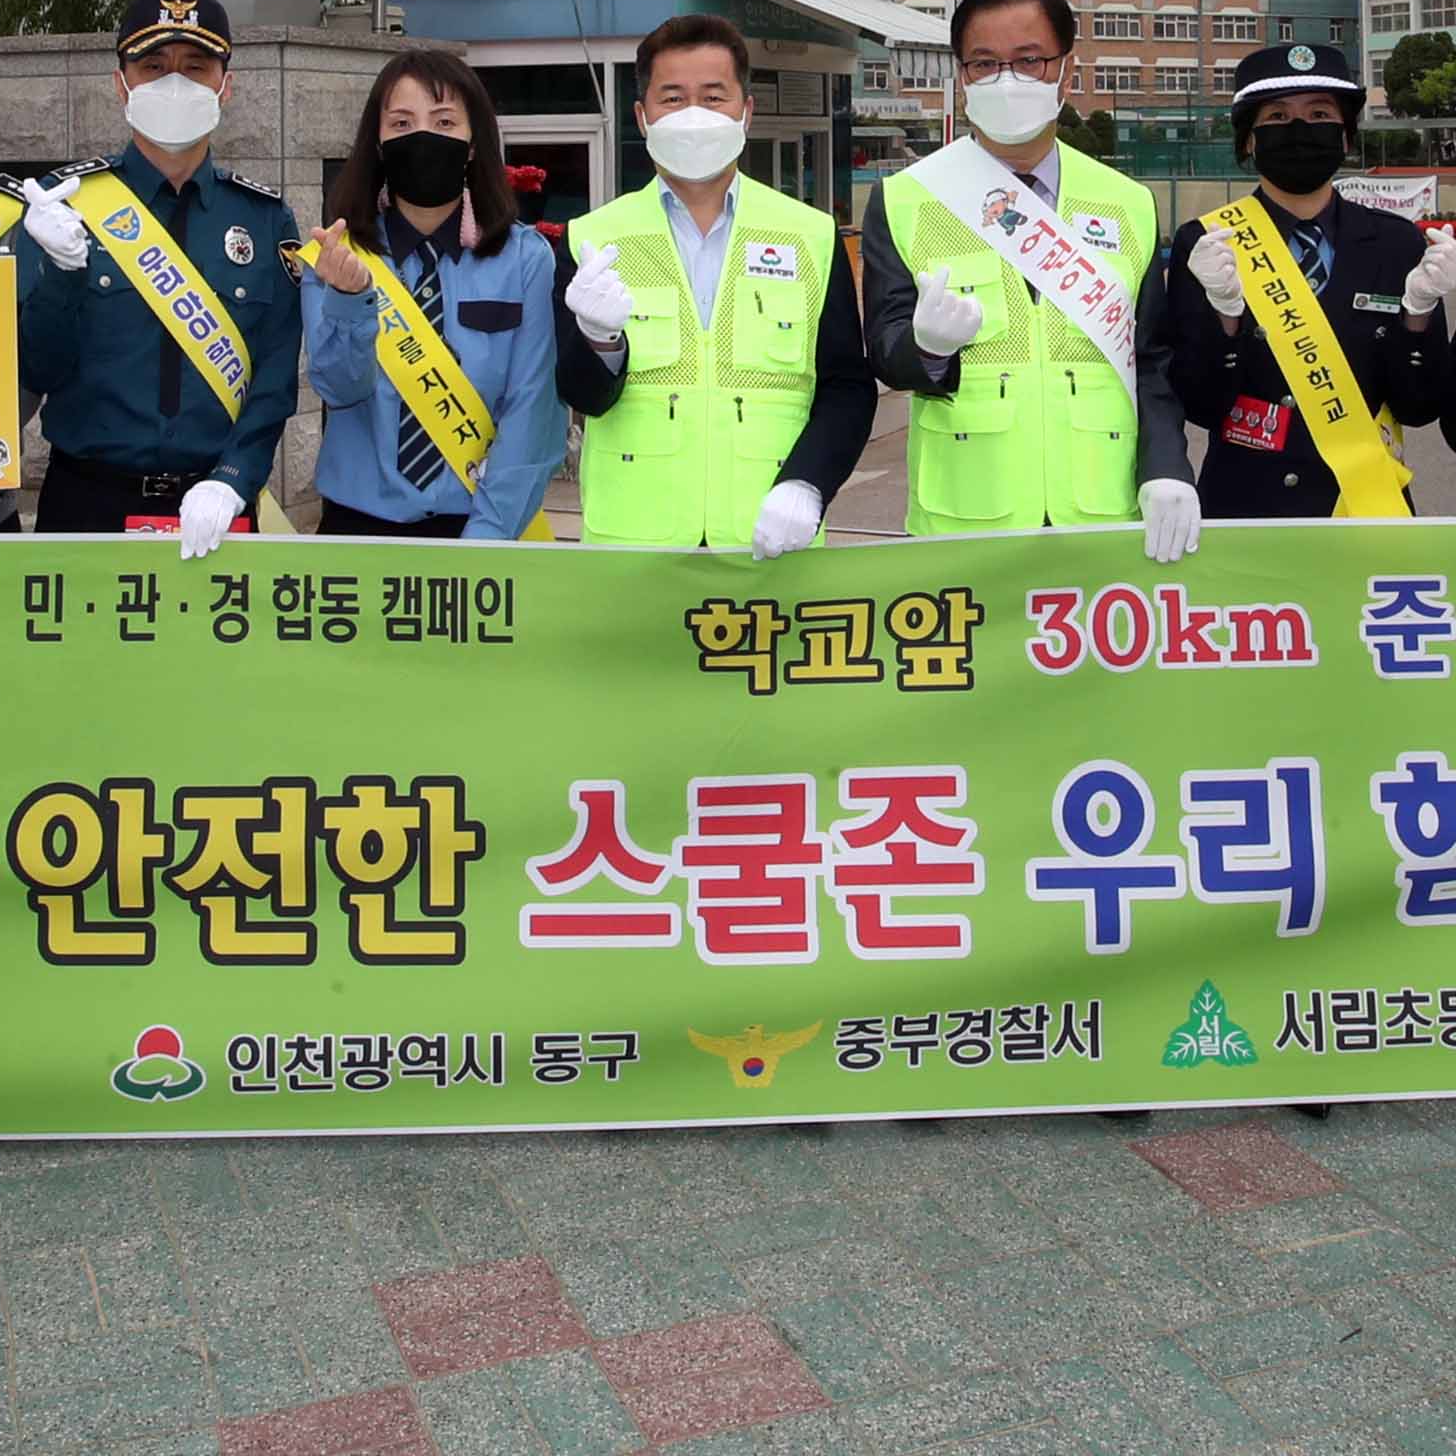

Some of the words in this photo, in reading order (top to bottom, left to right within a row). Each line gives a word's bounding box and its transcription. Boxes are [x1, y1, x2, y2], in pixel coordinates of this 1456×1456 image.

[137, 246, 186, 296] 우리
[172, 291, 219, 341] 아이
[417, 367, 481, 445] 지키자
[273, 575, 360, 643] 합동
[381, 577, 515, 644] 캠페인
[686, 587, 984, 695] 학교앞
[1026, 582, 1319, 676] 30km
[6, 776, 486, 967] 안전한
[520, 765, 985, 965] 스쿨존
[1026, 757, 1325, 954] 우리
[226, 1034, 506, 1095] 인천광역시
[529, 1032, 640, 1083] 동구
[835, 1000, 1104, 1073] 중부경찰서
